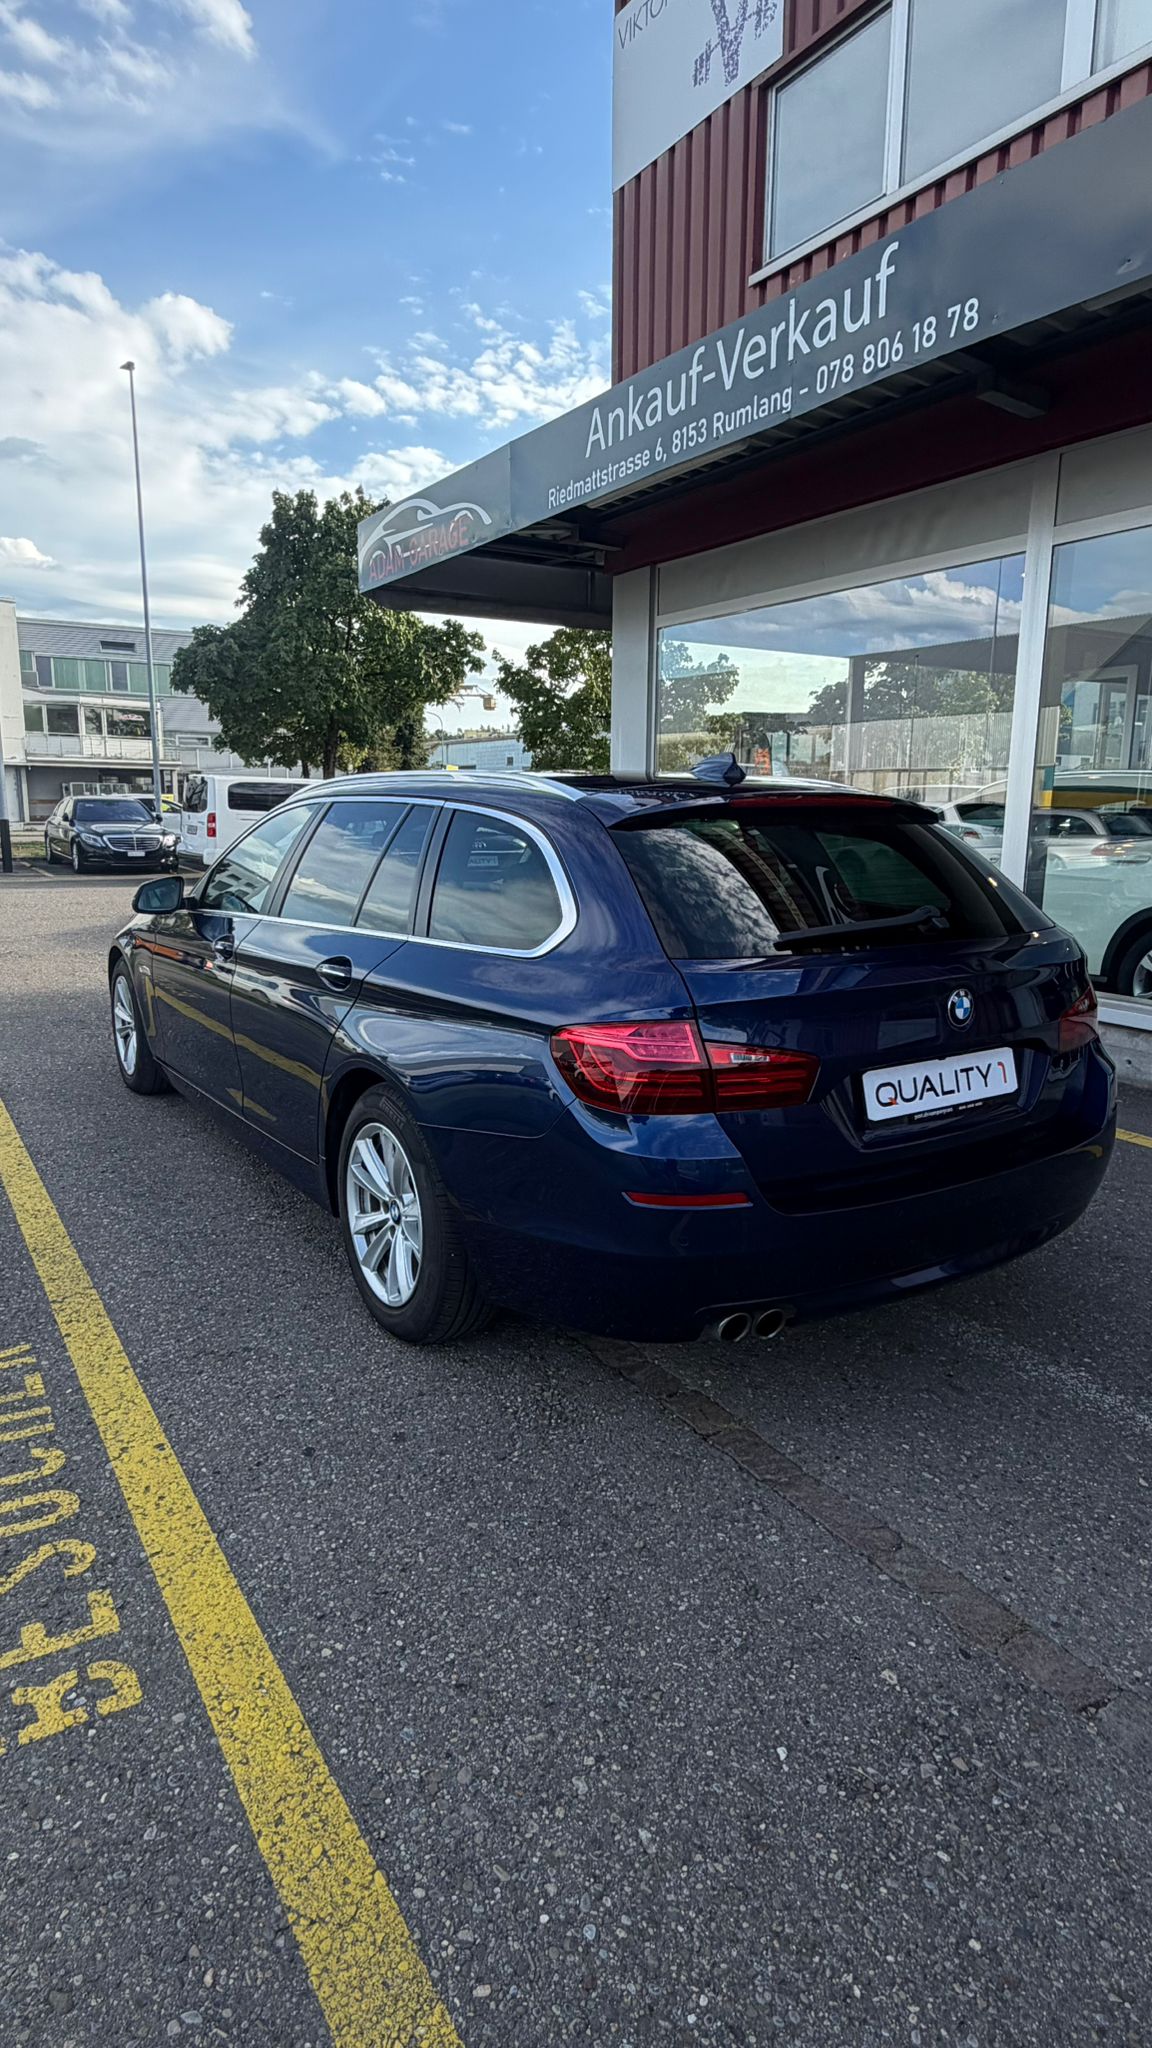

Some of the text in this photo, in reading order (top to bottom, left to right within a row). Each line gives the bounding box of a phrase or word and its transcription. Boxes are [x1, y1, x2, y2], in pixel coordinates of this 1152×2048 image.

[618, 0, 668, 49] VIKTO
[585, 240, 900, 459] Ankauf-Verkauf
[548, 449, 651, 510] Riedmattstrasse
[655, 437, 667, 463] 6,
[672, 418, 707, 454] 8153
[713, 385, 792, 438] Rumlang
[816, 353, 854, 394] 078
[862, 331, 903, 375] 806
[912, 315, 937, 353] 18
[947, 297, 979, 339] 78
[409, 515, 470, 567] GARAGE
[875, 1061, 1008, 1108] QUALITY 1
